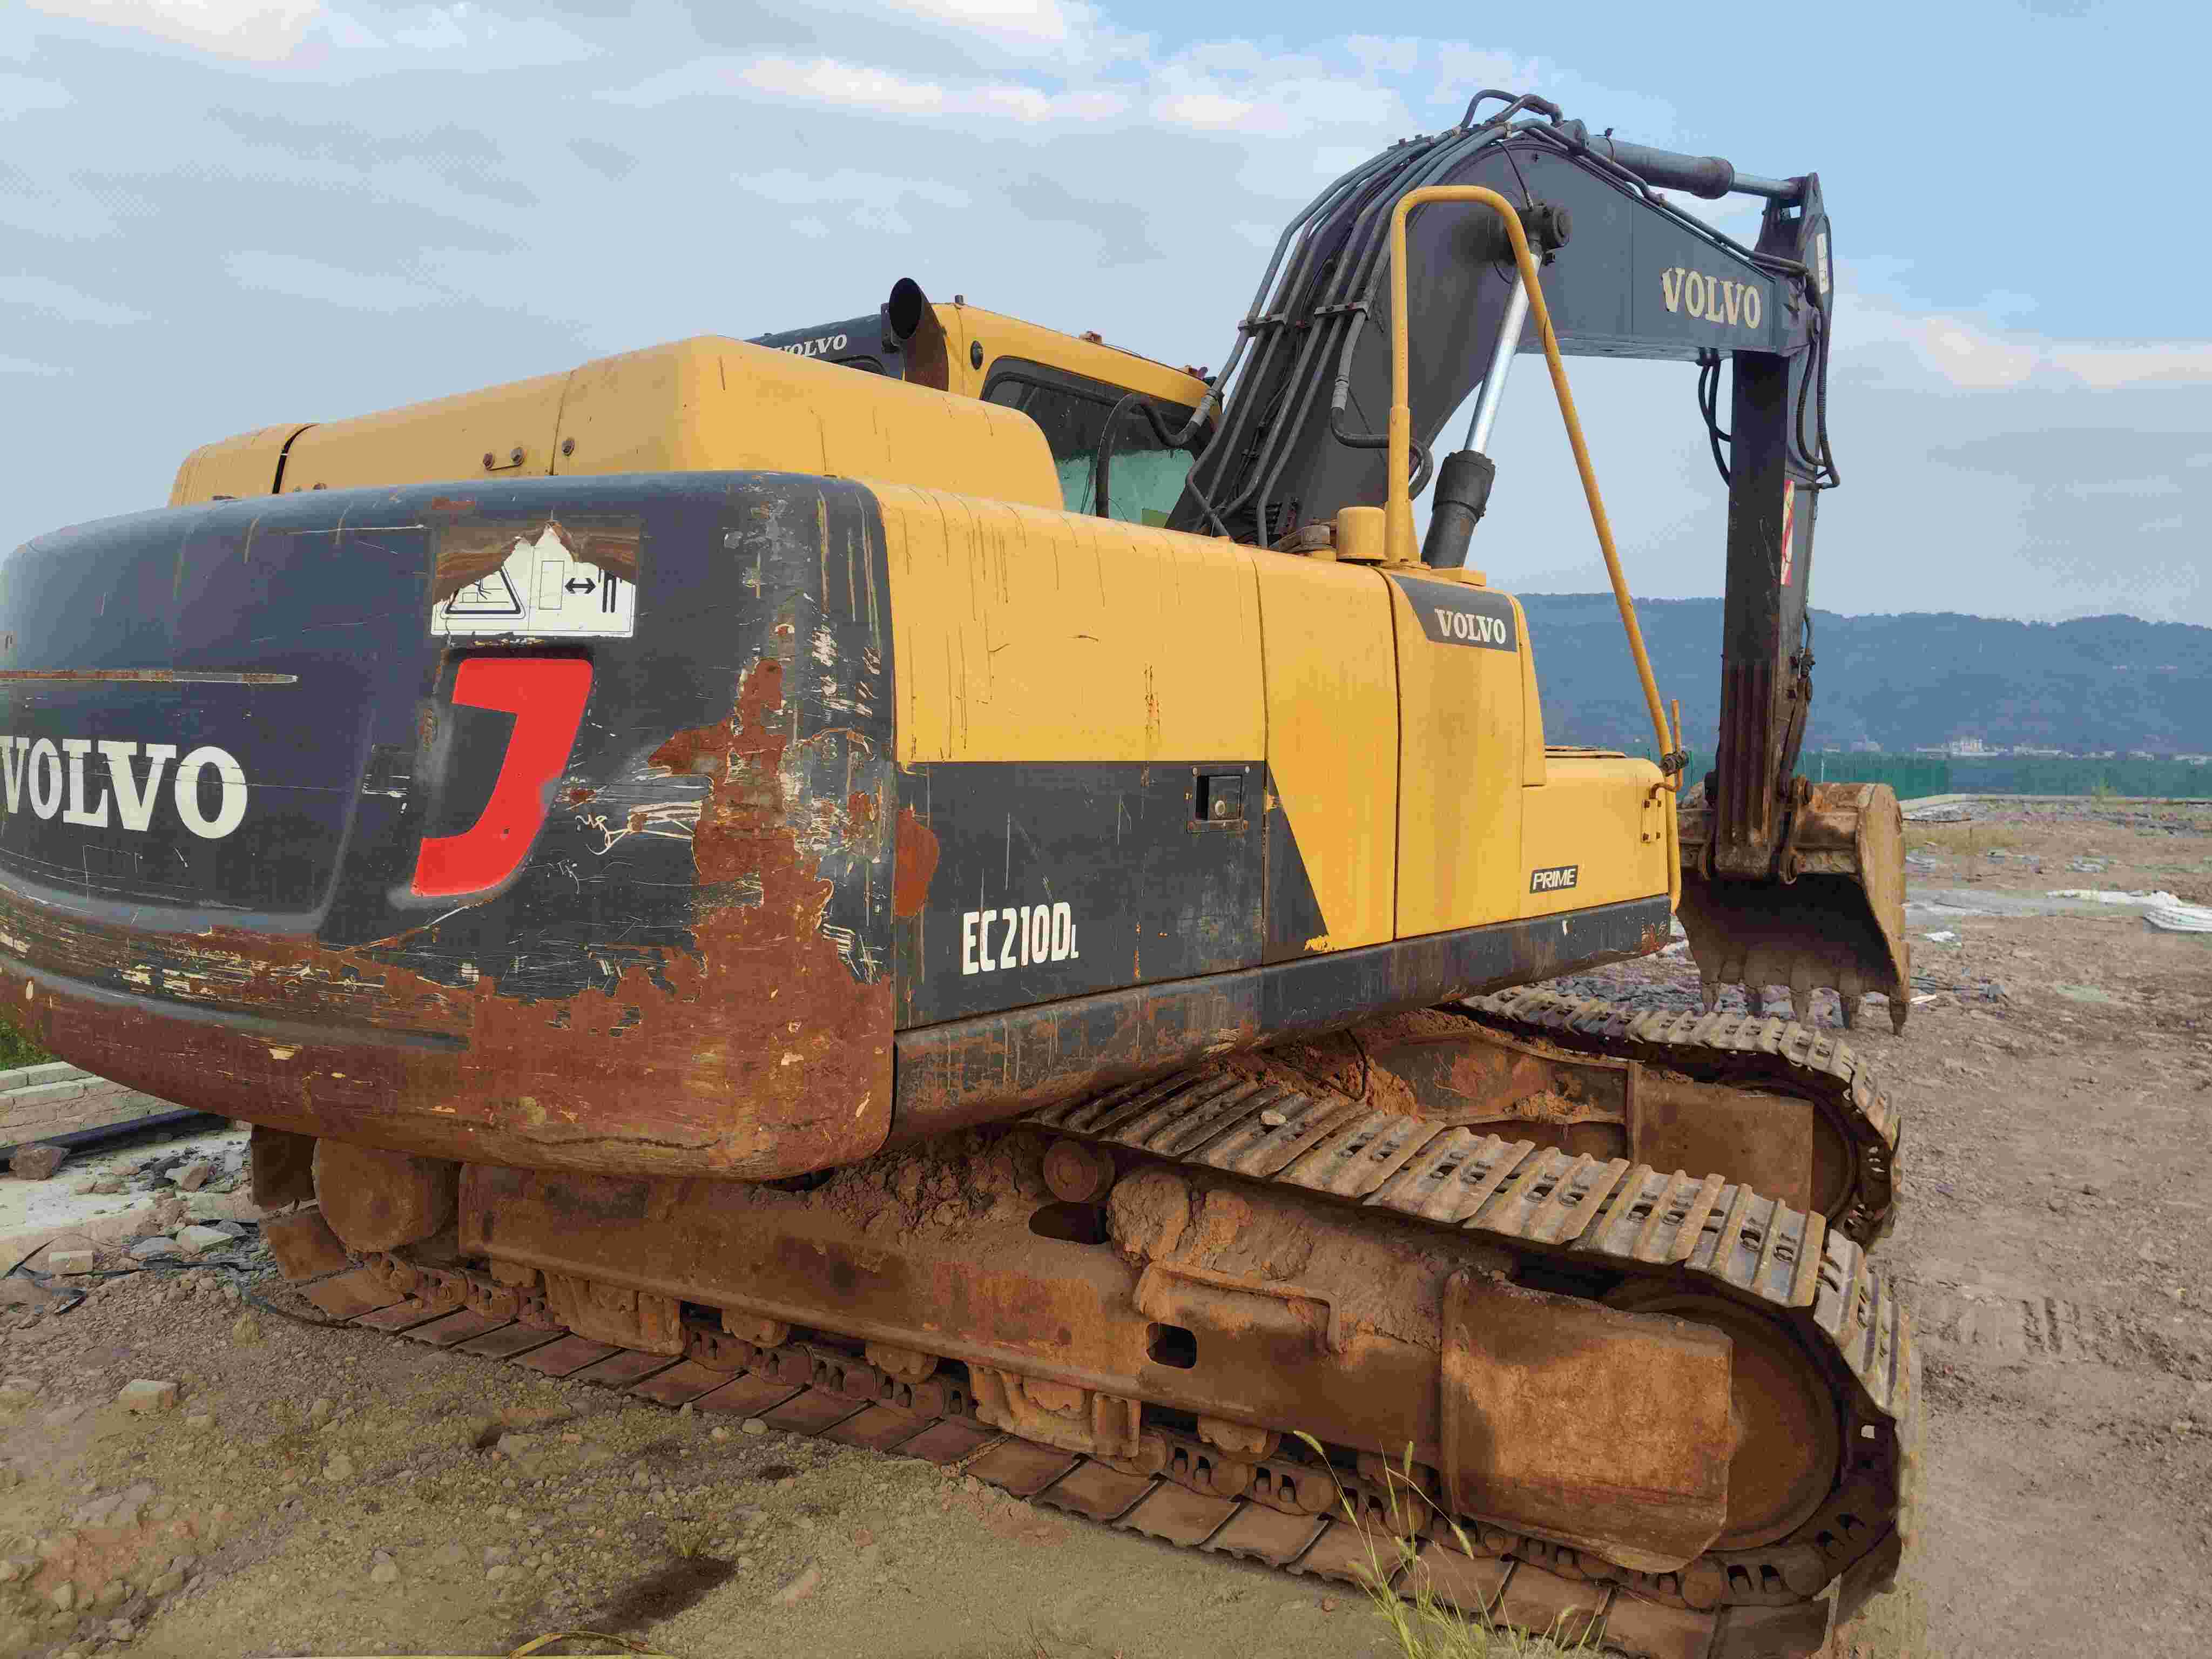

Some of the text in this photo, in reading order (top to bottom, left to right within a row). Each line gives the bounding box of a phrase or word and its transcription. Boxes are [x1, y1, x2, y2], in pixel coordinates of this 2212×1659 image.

[1662, 267, 1761, 328] VOLVO
[777, 334, 847, 356] OLVO
[1434, 609, 1506, 644] VOLVO
[0, 736, 248, 838] VOLVO
[1533, 868, 1576, 890] PRIME
